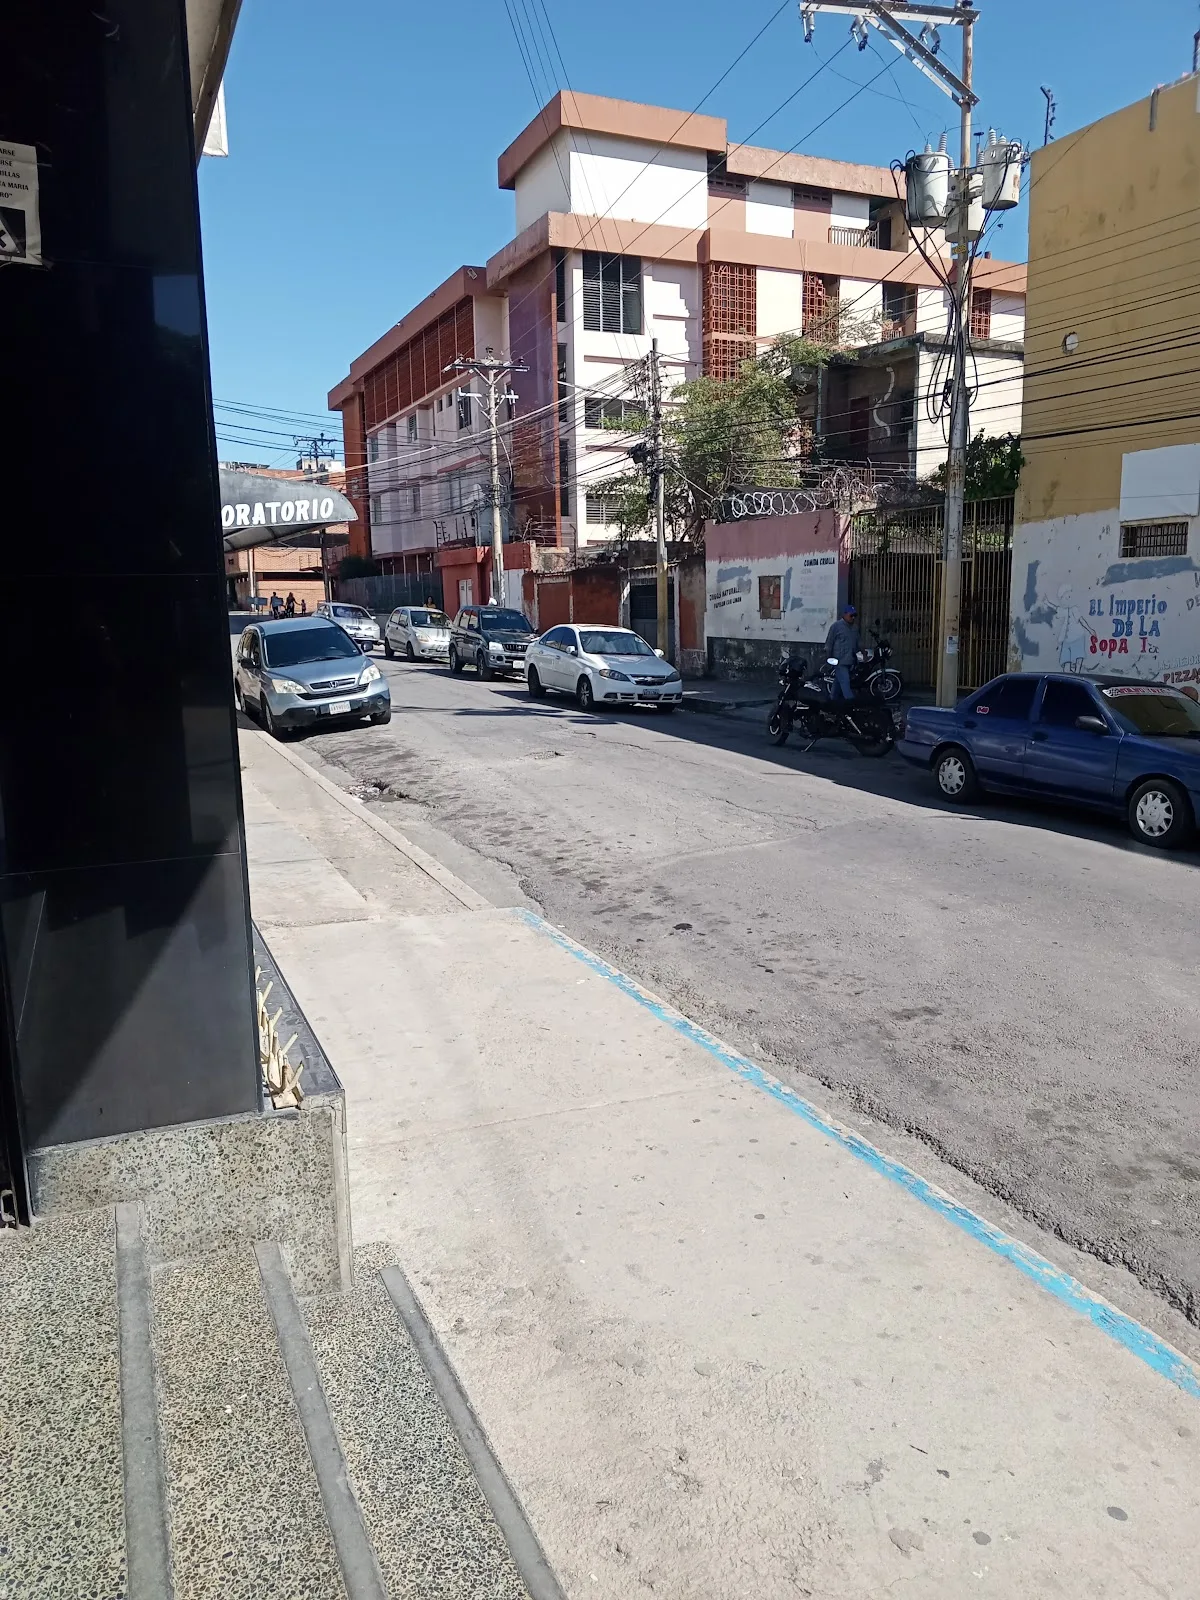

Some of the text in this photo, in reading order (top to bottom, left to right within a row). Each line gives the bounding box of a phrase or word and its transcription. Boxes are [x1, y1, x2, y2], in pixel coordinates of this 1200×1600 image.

[8, 182, 29, 191] MARIA
[1112, 615, 1161, 638] DE LA
